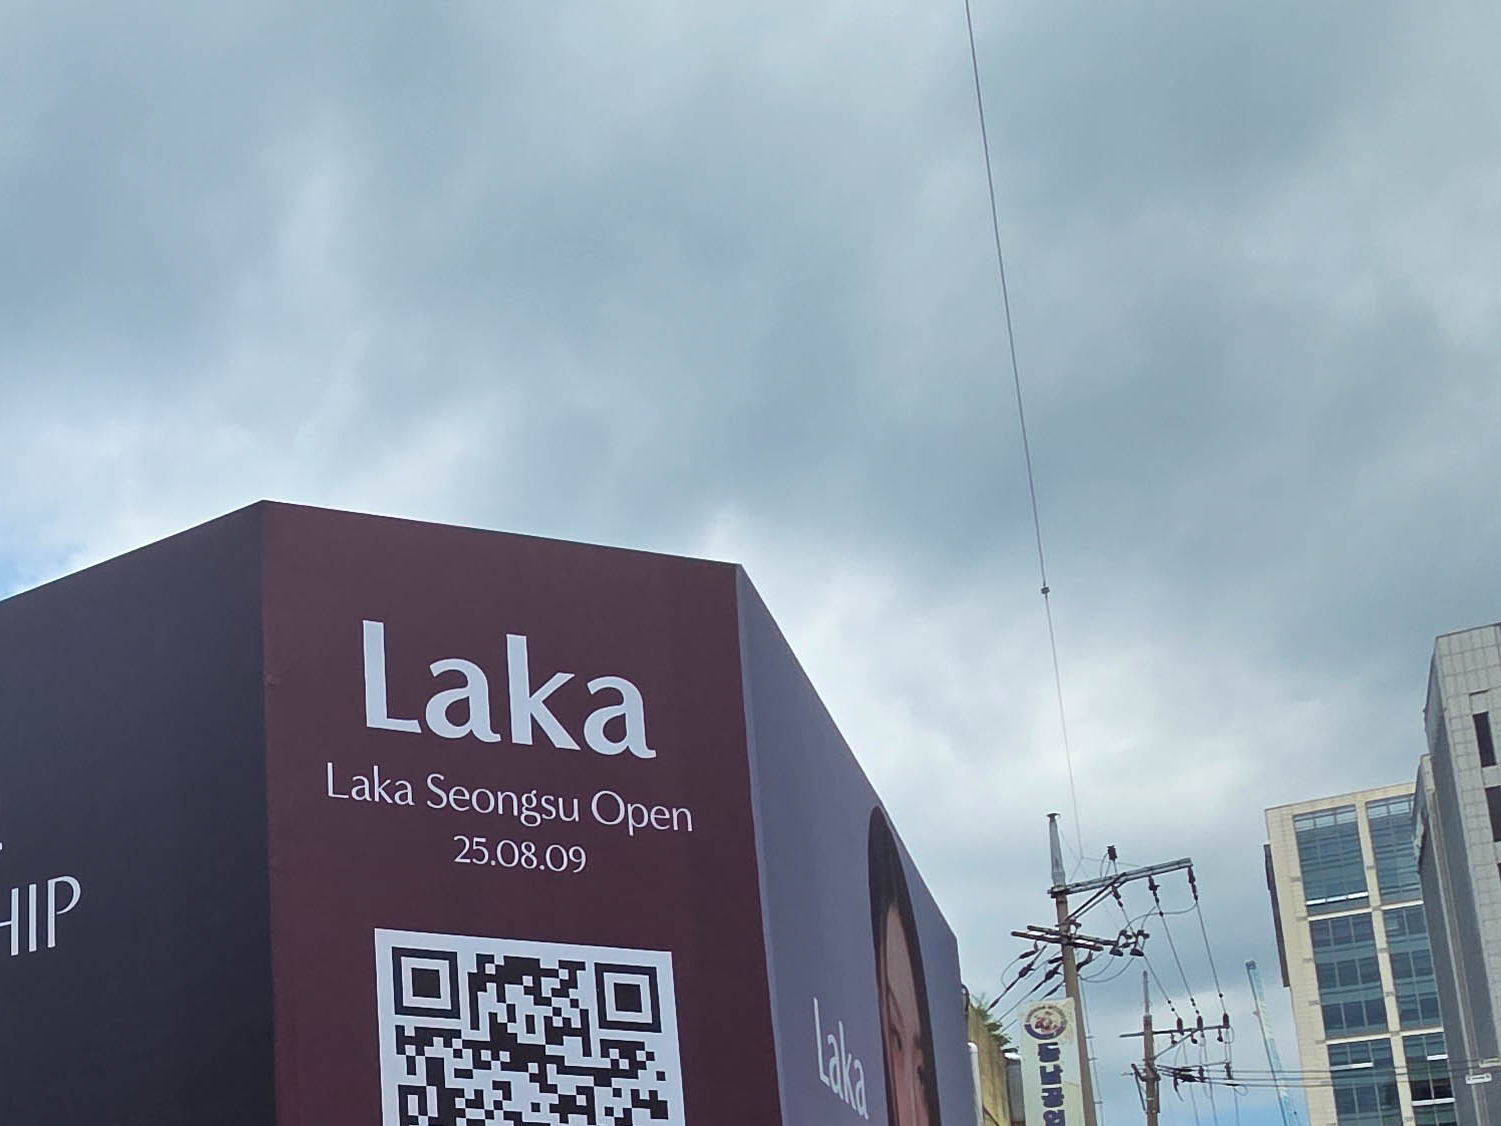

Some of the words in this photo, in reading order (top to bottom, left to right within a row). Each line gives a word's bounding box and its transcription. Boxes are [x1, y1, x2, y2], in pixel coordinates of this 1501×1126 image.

[362, 619, 657, 760] Laka
[326, 762, 415, 807] Laka
[426, 773, 579, 827] Seongsu
[591, 791, 694, 837] Open
[453, 835, 587, 873] 25.08.09
[812, 996, 870, 1121] Laka
